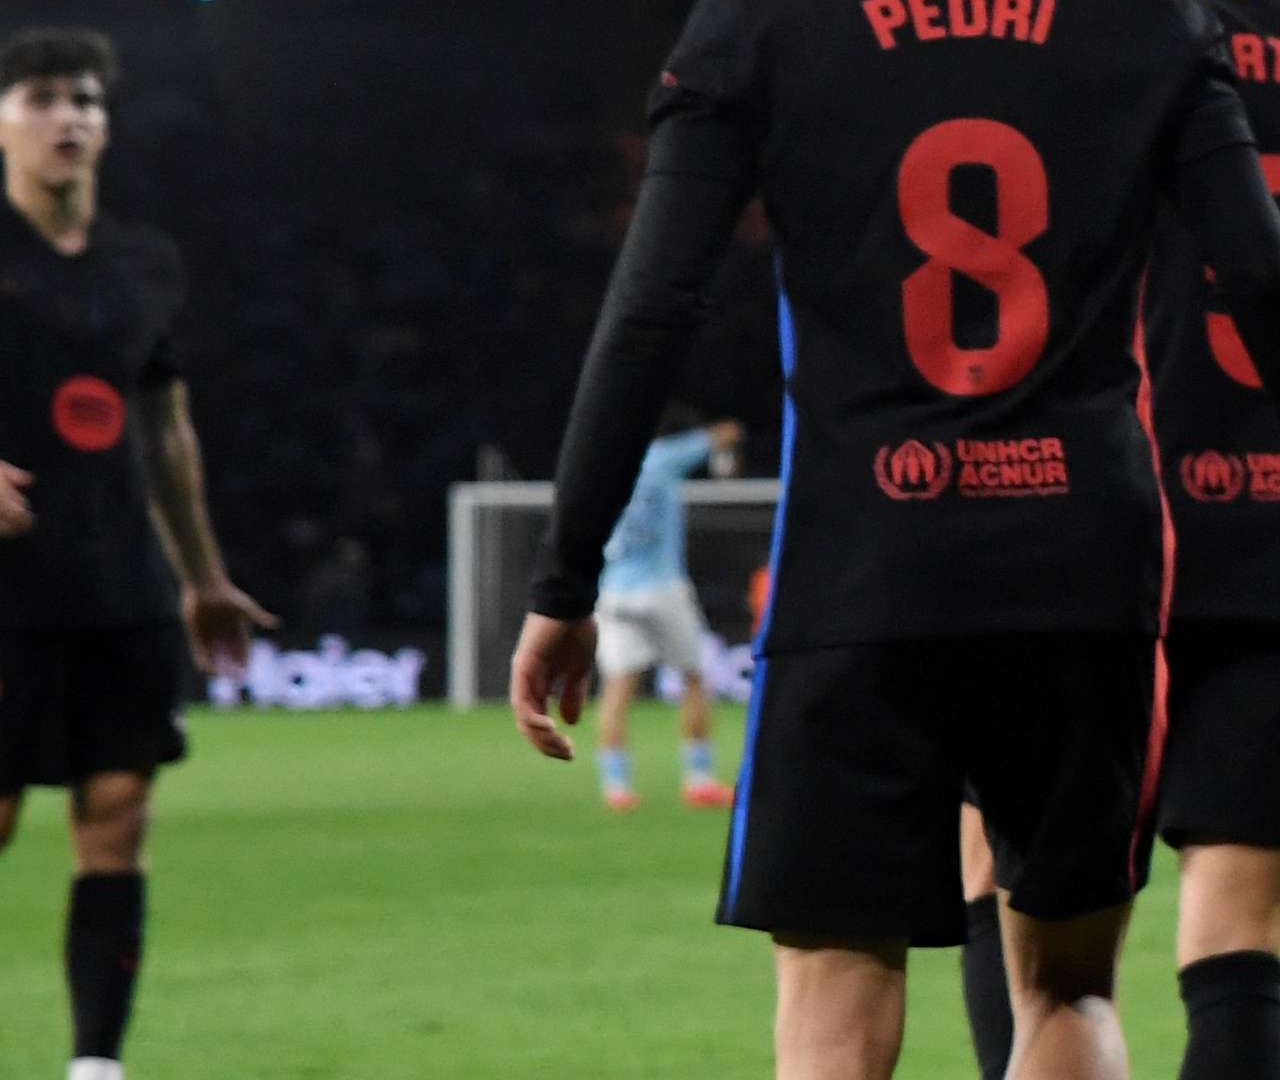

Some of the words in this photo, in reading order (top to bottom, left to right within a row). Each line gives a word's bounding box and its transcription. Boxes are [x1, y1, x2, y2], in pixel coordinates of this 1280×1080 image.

[897, 117, 1050, 396] 8
[957, 437, 1064, 462] UNHCR
[959, 462, 1067, 486] ACNUR
